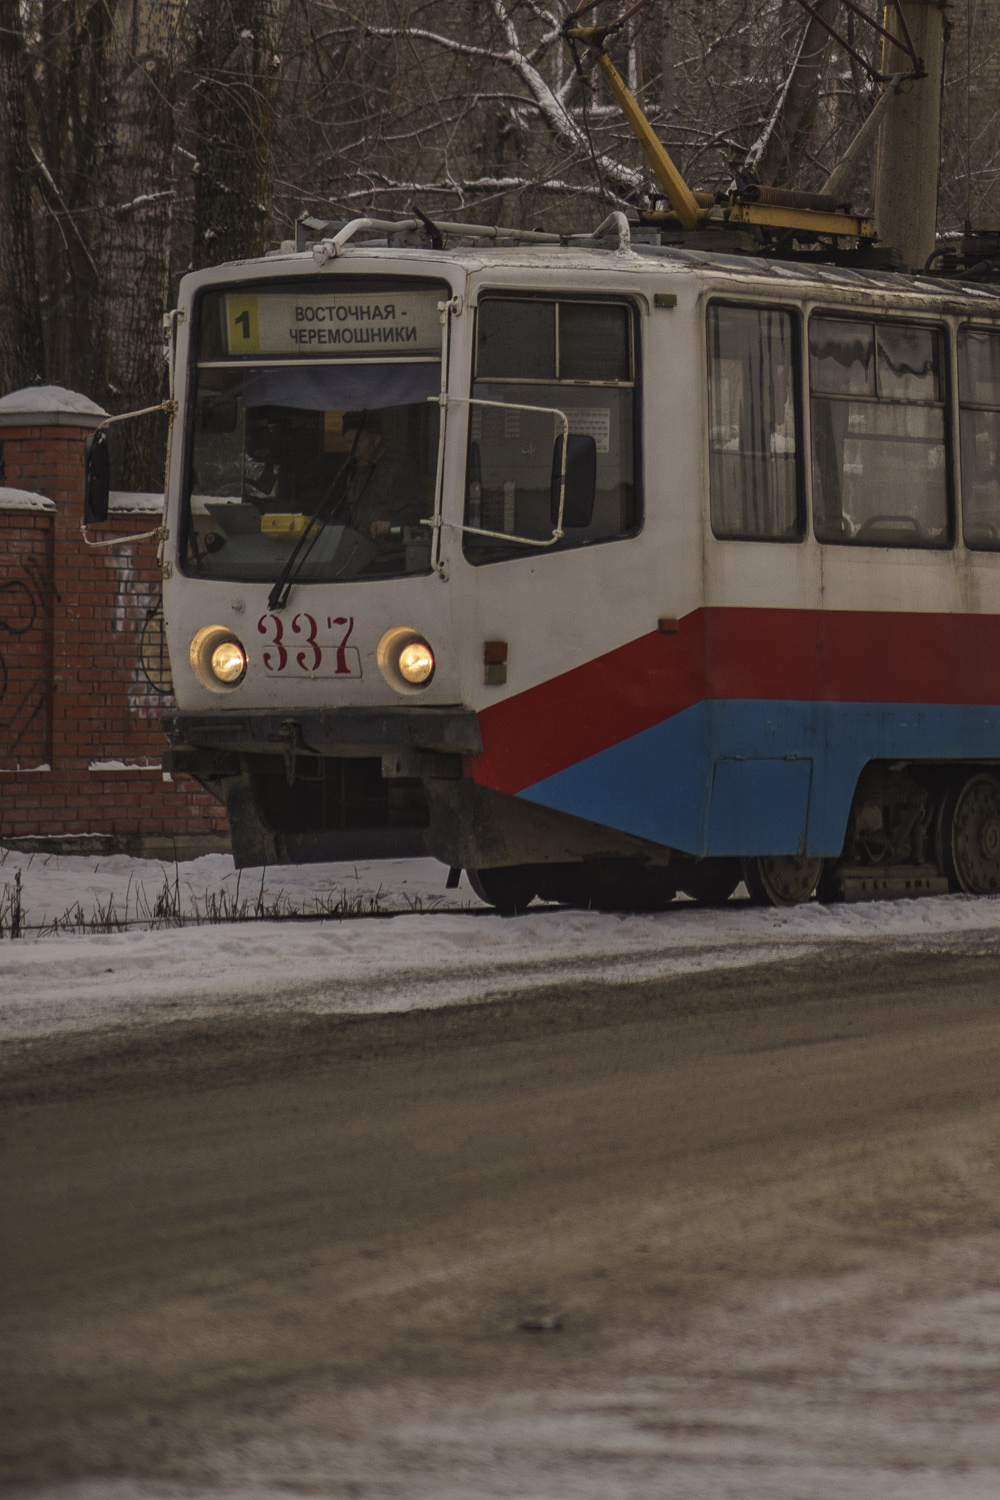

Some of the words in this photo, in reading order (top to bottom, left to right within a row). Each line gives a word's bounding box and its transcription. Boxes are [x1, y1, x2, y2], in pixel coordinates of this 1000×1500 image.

[235, 310, 250, 339] 1
[295, 305, 396, 322] ВОСТОЧНАЯ
[289, 326, 417, 344] ЧЕРЕМОШНИКИ
[257, 612, 354, 674] 337
